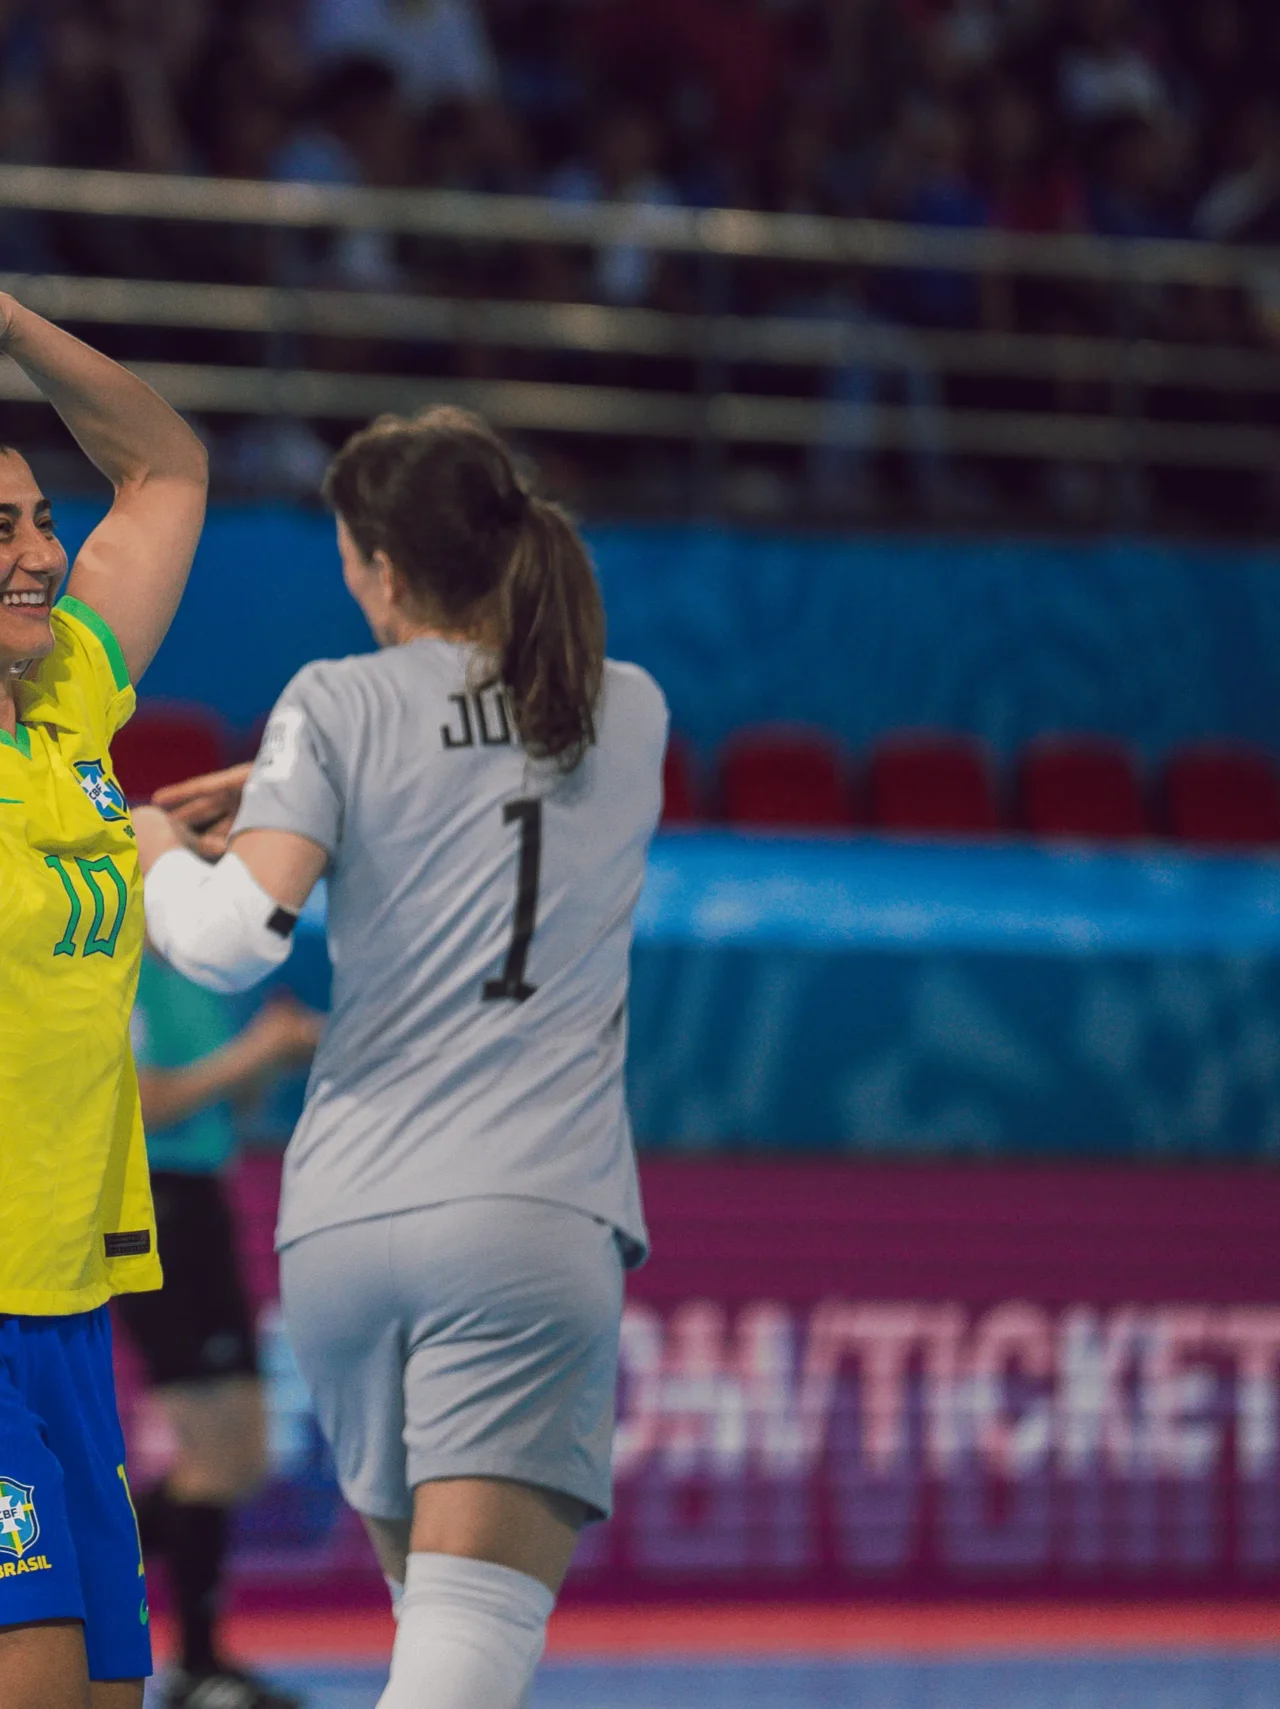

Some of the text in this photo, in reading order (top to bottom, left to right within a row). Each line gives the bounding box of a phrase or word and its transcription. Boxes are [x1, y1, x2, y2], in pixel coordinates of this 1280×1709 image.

[88, 783, 103, 800] CBF
[44, 854, 128, 958] 10
[480, 798, 542, 1004] 1
